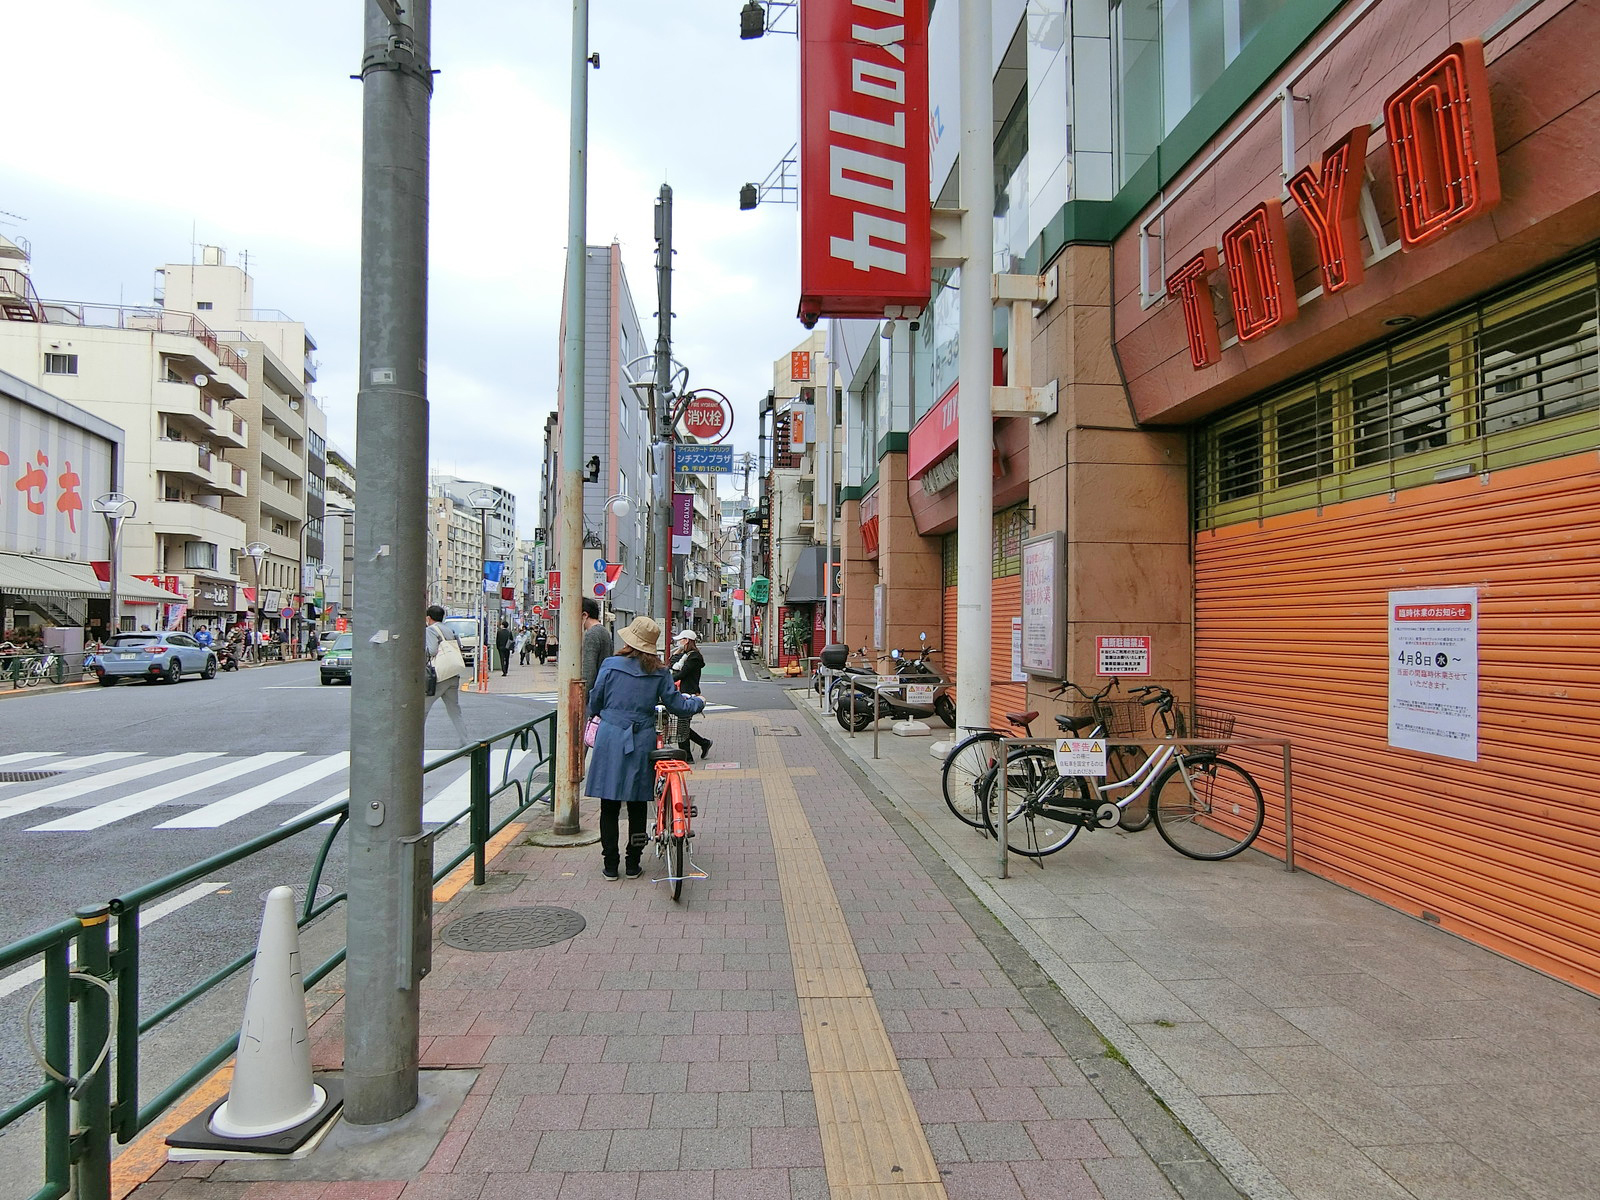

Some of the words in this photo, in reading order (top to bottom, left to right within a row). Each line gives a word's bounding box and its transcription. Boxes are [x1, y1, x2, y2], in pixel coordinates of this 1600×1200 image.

[1166, 37, 1500, 371] TOYO
[687, 409, 722, 427] 消火栓
[677, 454, 732, 464] シチズンプラザ
[683, 498, 691, 519] TOKYO
[682, 519, 690, 535] 2020
[1398, 608, 1466, 618] 臨時休業のお知らせ
[1397, 669, 1468, 681] 当面の間臨時休業させて
[1409, 680, 1450, 691] いただきます。
[1072, 742, 1090, 752] 警告
